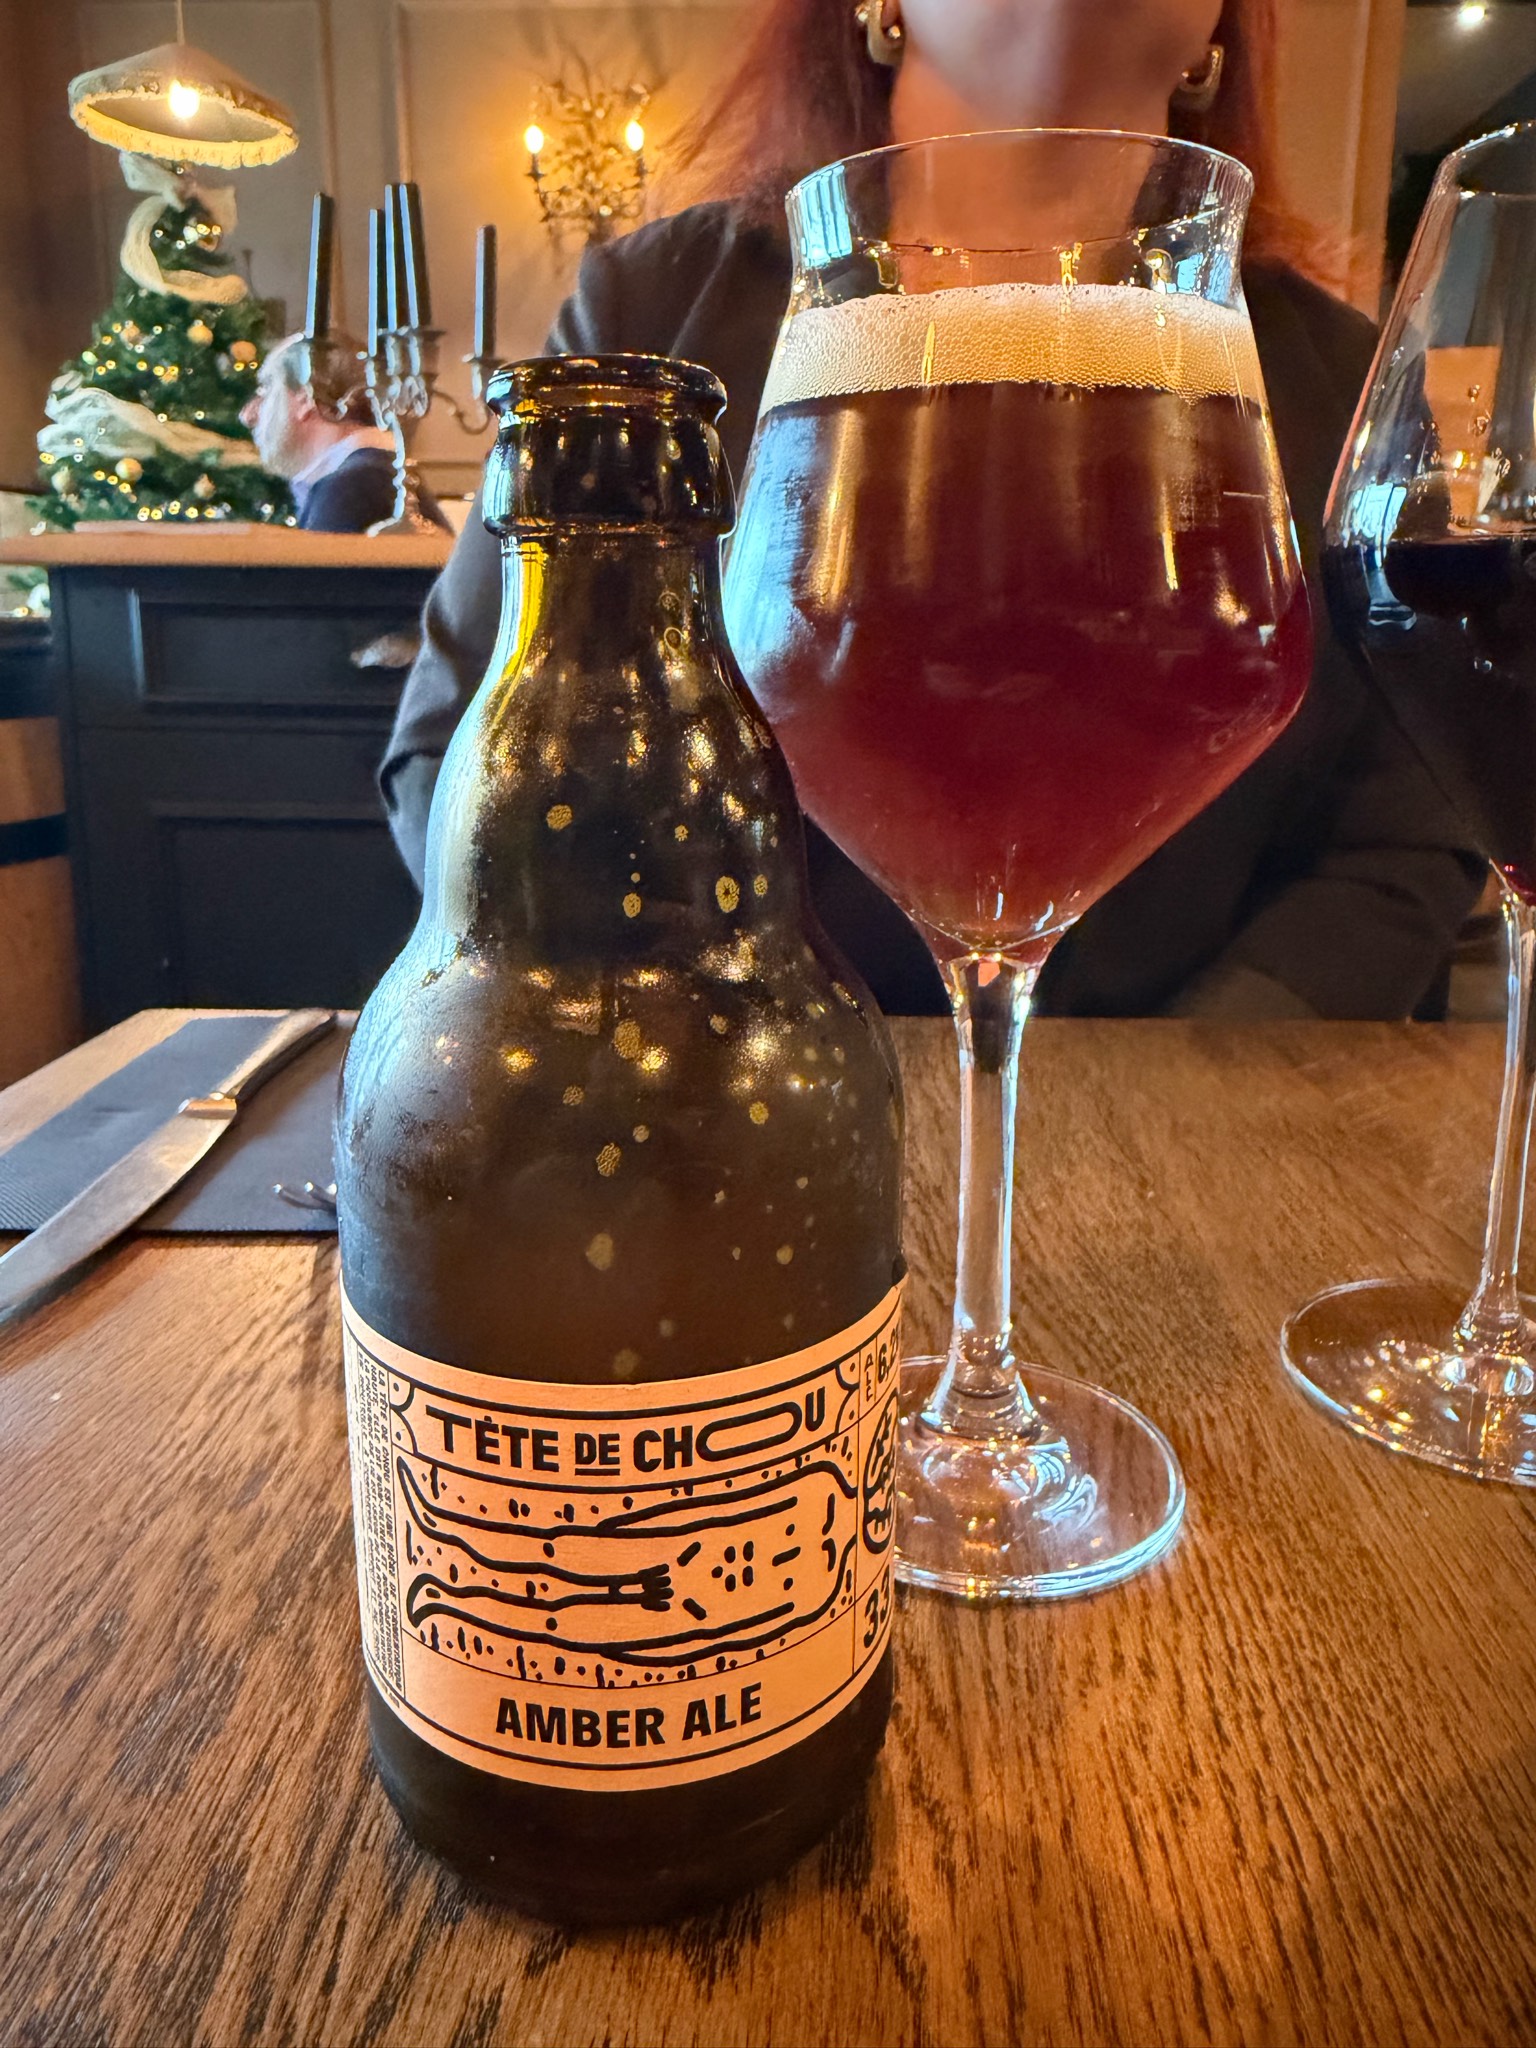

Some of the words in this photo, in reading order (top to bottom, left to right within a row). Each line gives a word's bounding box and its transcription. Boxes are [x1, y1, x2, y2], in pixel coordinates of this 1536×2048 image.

[425, 1405, 559, 1474] TÊTE
[574, 1433, 620, 1468] DE
[633, 1387, 827, 1473] CHOU
[496, 1697, 666, 1748] AMBER
[682, 1683, 763, 1741] ALE
